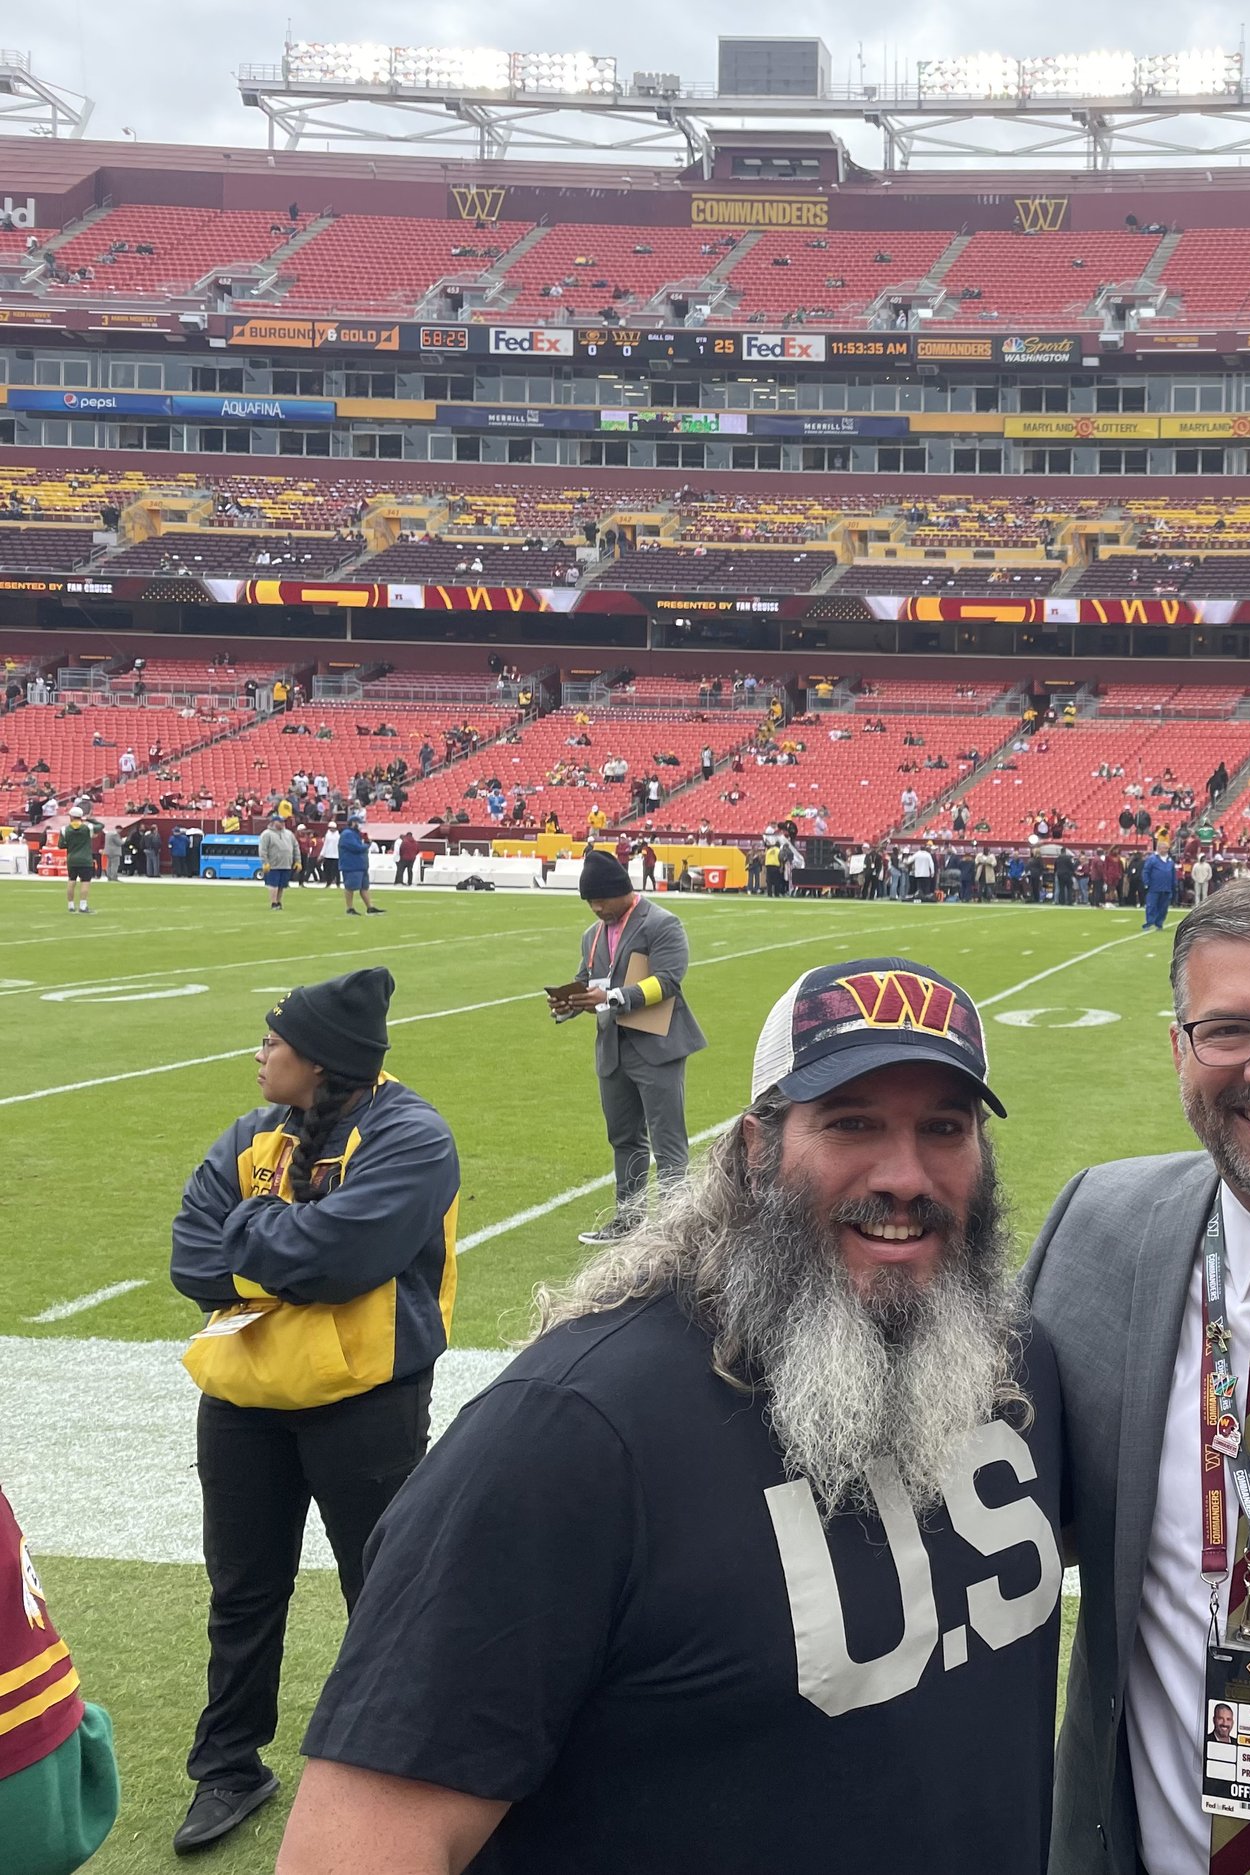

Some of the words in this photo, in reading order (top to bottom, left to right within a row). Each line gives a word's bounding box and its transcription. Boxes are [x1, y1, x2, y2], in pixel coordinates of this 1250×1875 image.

[692, 200, 828, 226] COMMANDERS
[101, 315, 108, 326] 3
[250, 326, 325, 340] BURGUNDY
[327, 328, 338, 342] &
[340, 329, 376, 342] GOLD
[422, 330, 466, 346] 68:25
[495, 330, 562, 352] FedEx
[714, 340, 734, 353] 25
[746, 336, 813, 358] FedEx
[1024, 336, 1074, 352] Sports
[588, 344, 597, 356] 0
[622, 345, 632, 356] 0
[832, 342, 884, 354] 11:53:35
[886, 342, 908, 354] AM
[918, 342, 992, 356] COMMANDERS
[1004, 353, 1070, 362] WASHINGTON
[80, 397, 117, 410] pepsi
[221, 400, 283, 418] AQUAFINA
[488, 414, 526, 422] MERRILL
[804, 422, 841, 430] MERRILL
[1023, 422, 1074, 432] MARYLAND
[1096, 423, 1138, 432] LOTTERY
[1179, 422, 1231, 432] MARYLAND
[48, 583, 63, 591] BY
[656, 600, 717, 610] PRESENTED
[719, 602, 733, 610] BY
[736, 601, 751, 612] FAN
[1208, 1254, 1217, 1302] COMMANDERS
[1212, 1490, 1221, 1545] COMMANDERS
